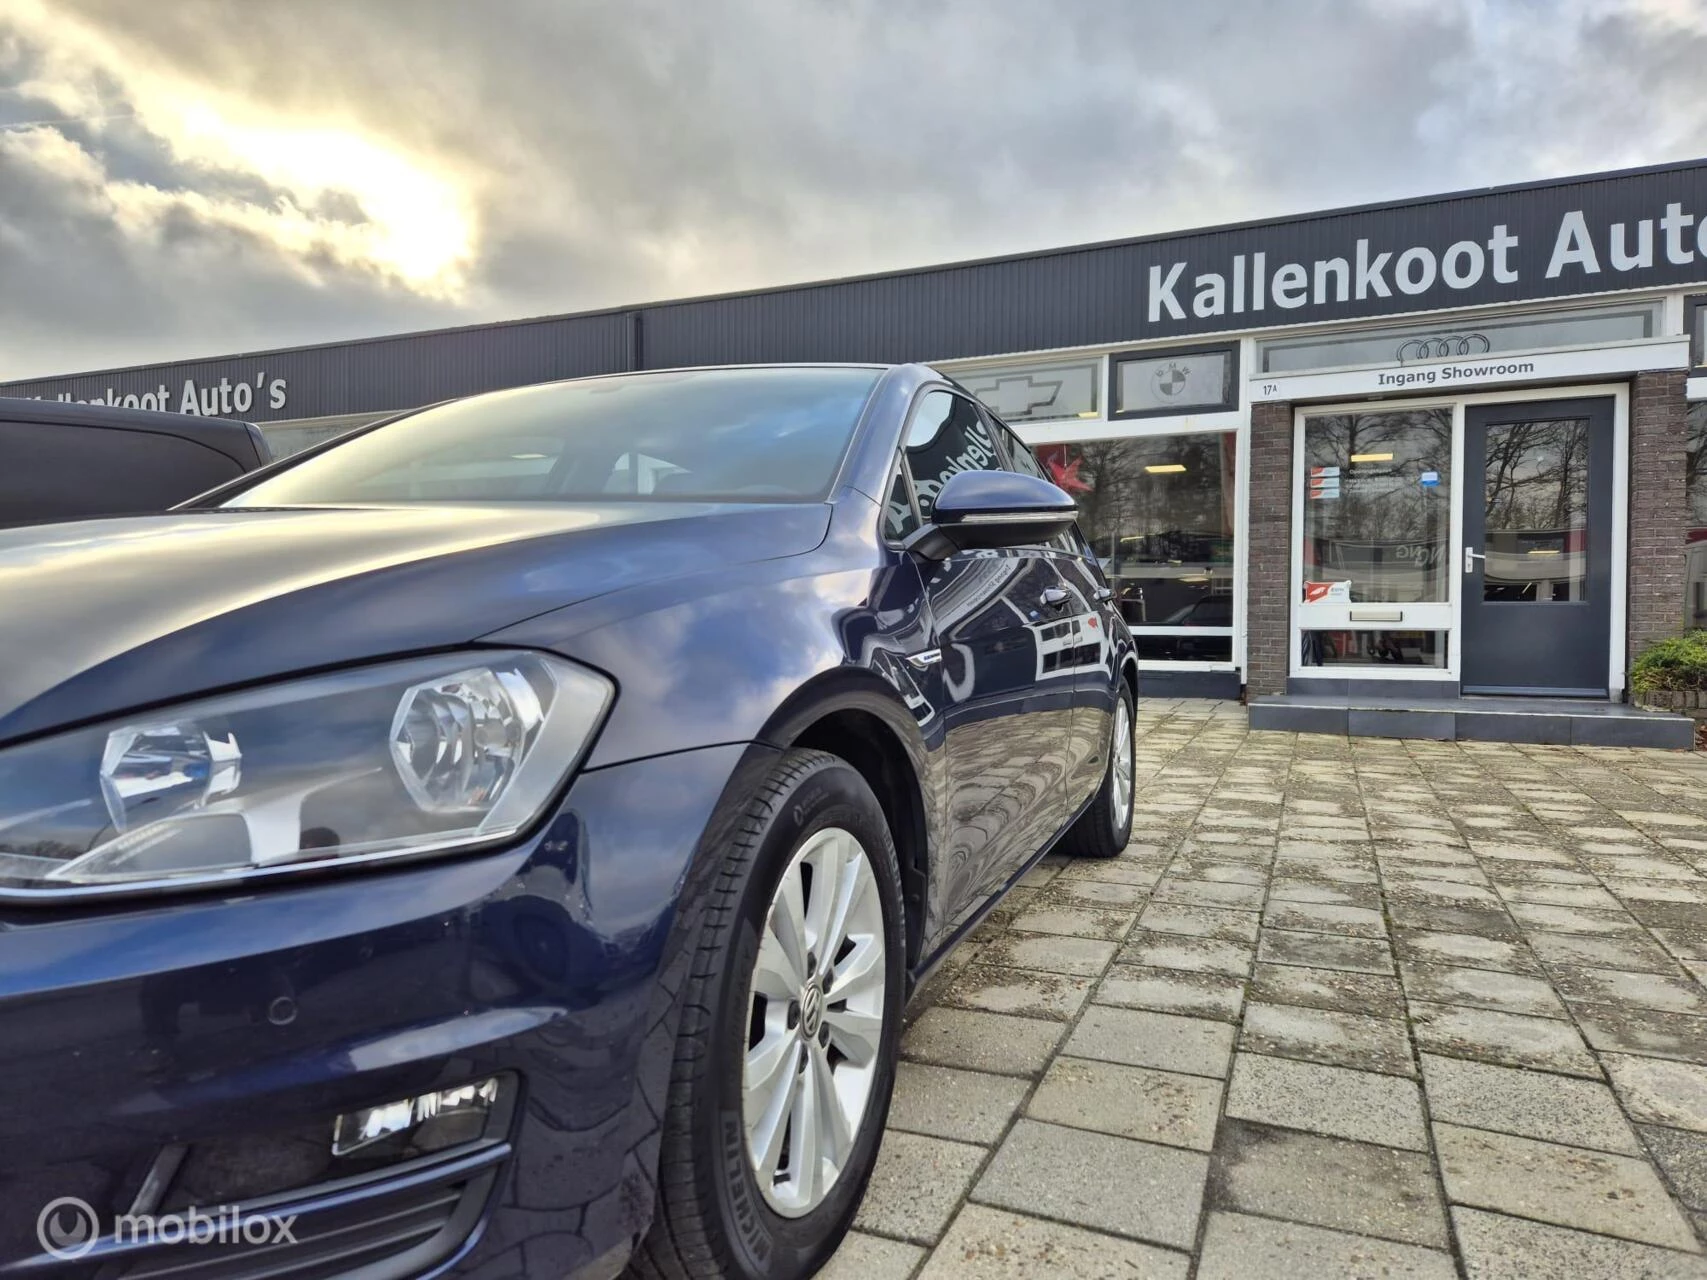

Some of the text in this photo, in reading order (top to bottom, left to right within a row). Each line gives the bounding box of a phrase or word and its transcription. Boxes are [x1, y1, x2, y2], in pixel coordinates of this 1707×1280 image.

[1147, 202, 1707, 323] Kallenkoot Aut
[179, 372, 287, 417] Auto's
[1378, 361, 1535, 386] Ingang Showroom
[723, 1121, 771, 1262] MICHELIN
